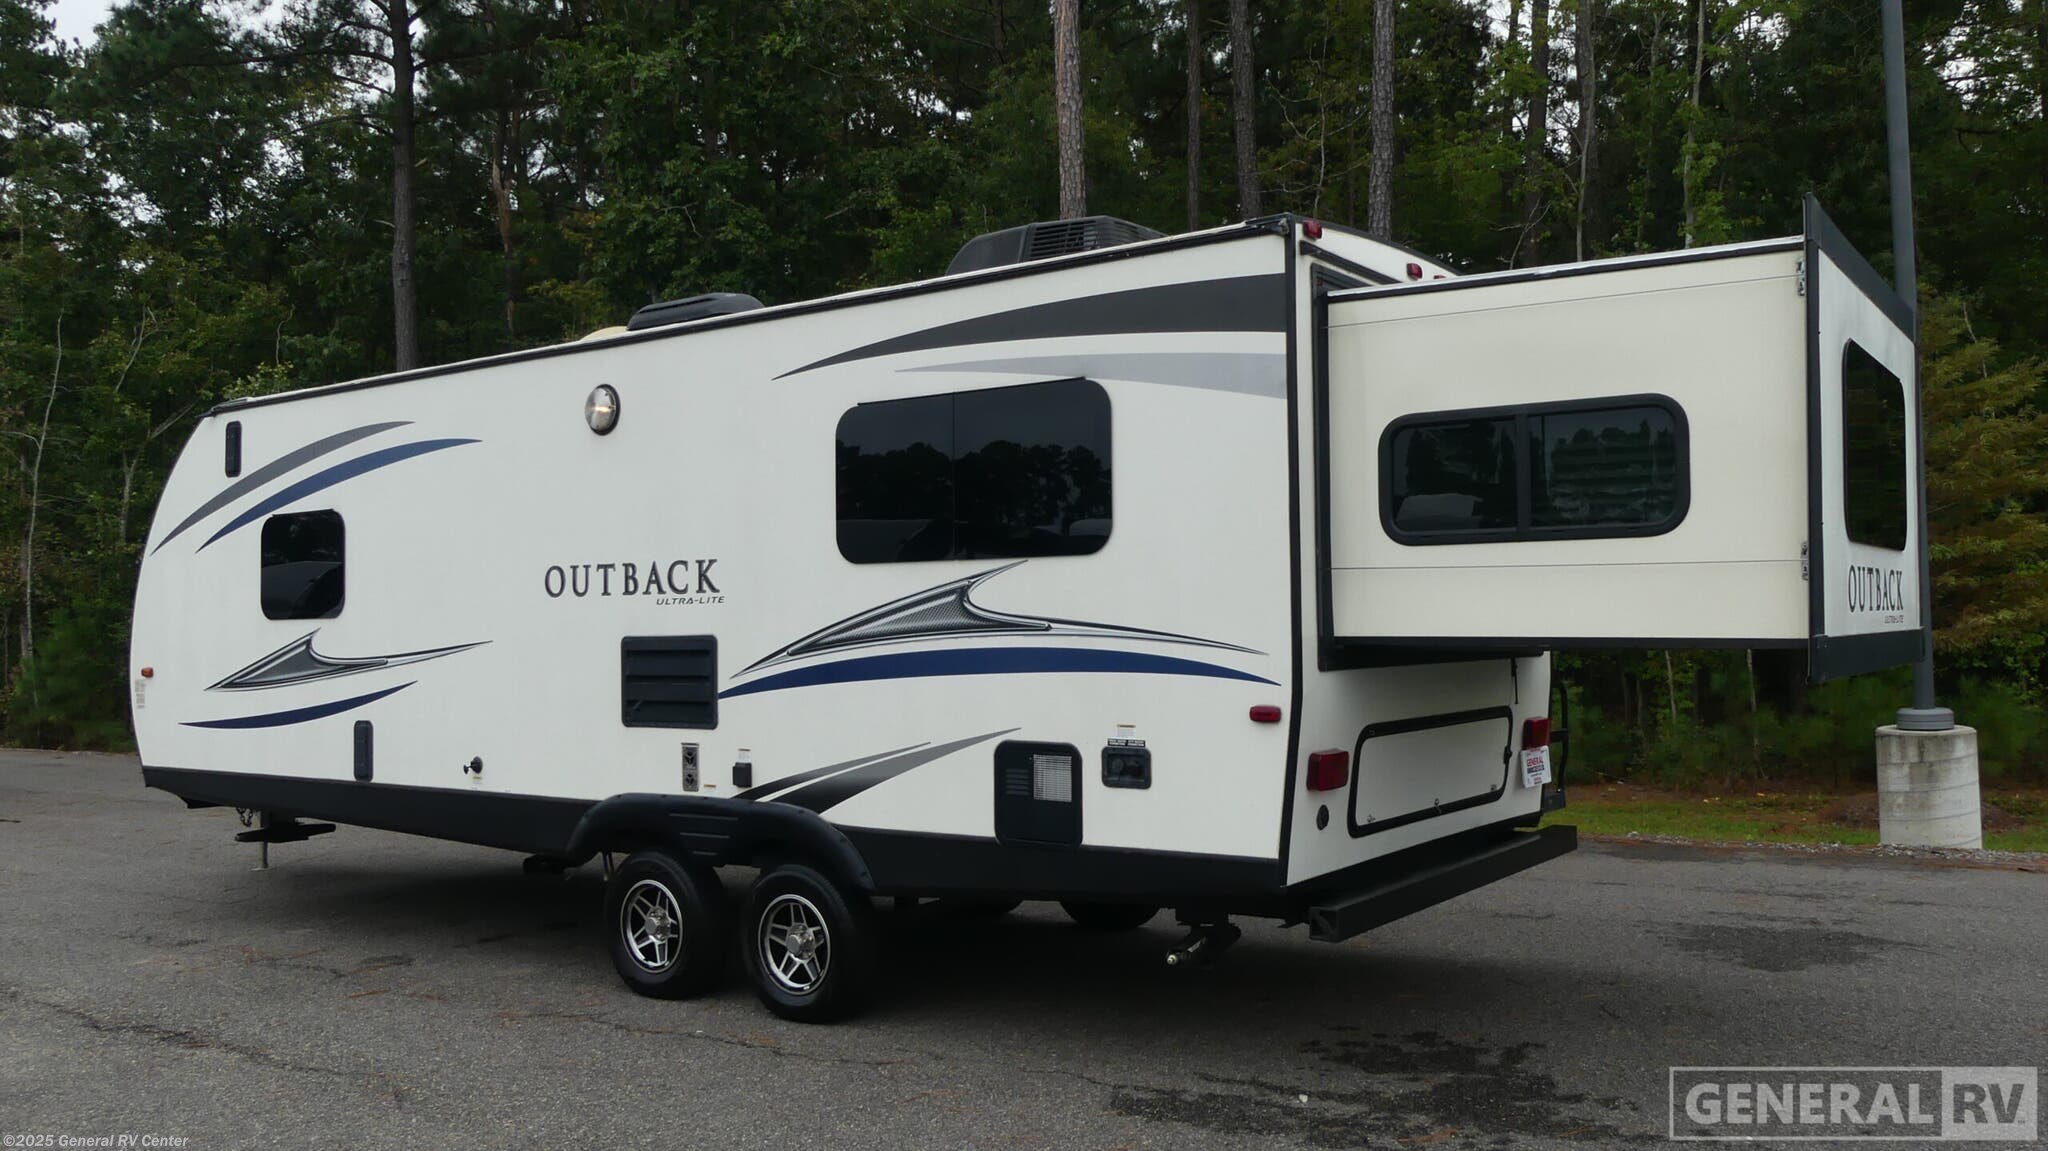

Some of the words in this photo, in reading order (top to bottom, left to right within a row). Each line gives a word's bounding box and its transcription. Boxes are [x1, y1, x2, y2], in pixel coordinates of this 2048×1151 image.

[544, 558, 720, 598] OUTBACK
[1848, 564, 1904, 613] OUTBACK
[656, 595, 725, 606] ULTRA-LITE
